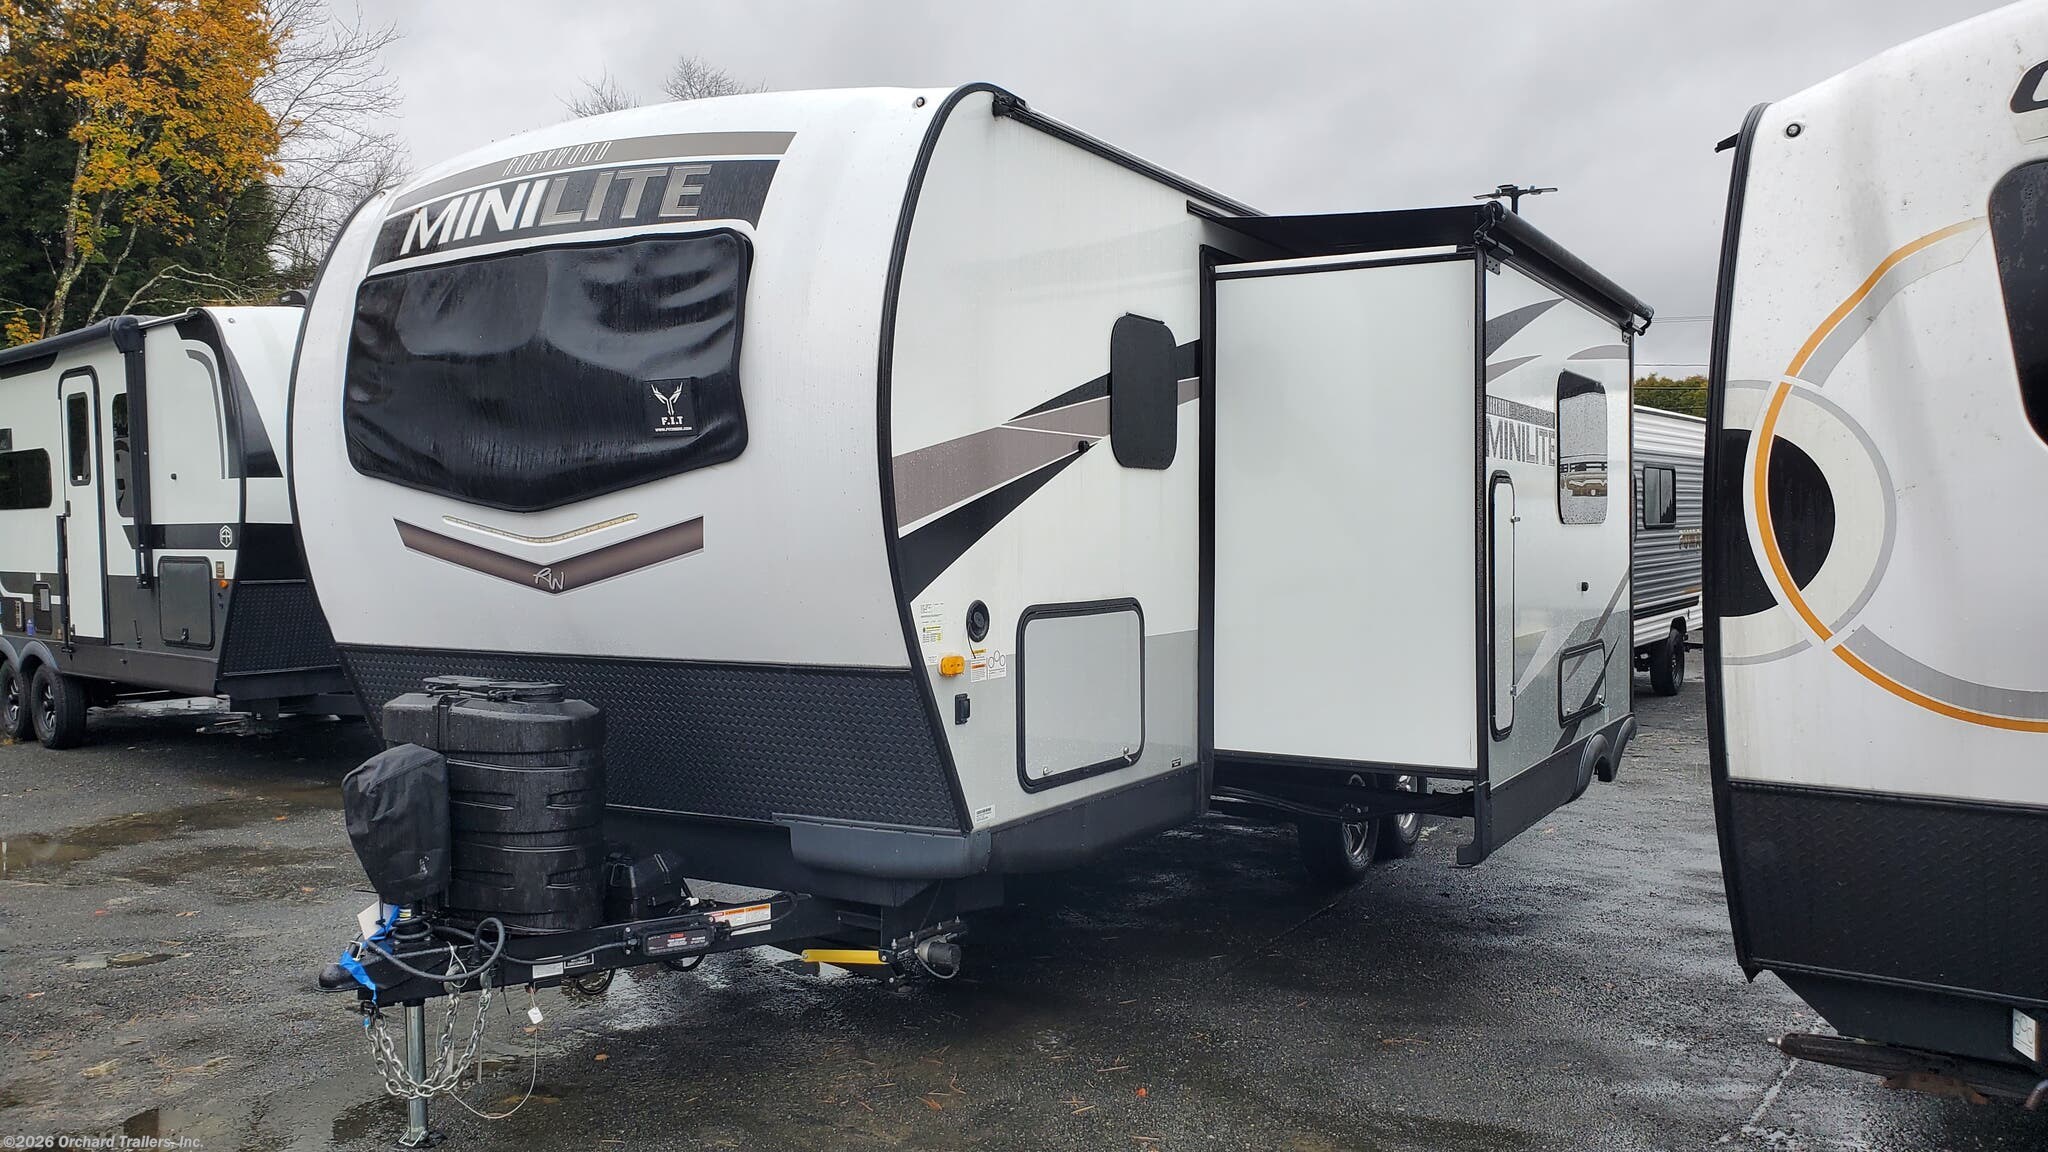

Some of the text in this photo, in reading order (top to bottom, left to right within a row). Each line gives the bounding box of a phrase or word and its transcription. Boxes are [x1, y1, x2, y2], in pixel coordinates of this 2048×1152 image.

[502, 141, 613, 177] ROCKWOOD
[400, 164, 713, 255] MINILITE
[1486, 416, 1555, 467] MINILITE
